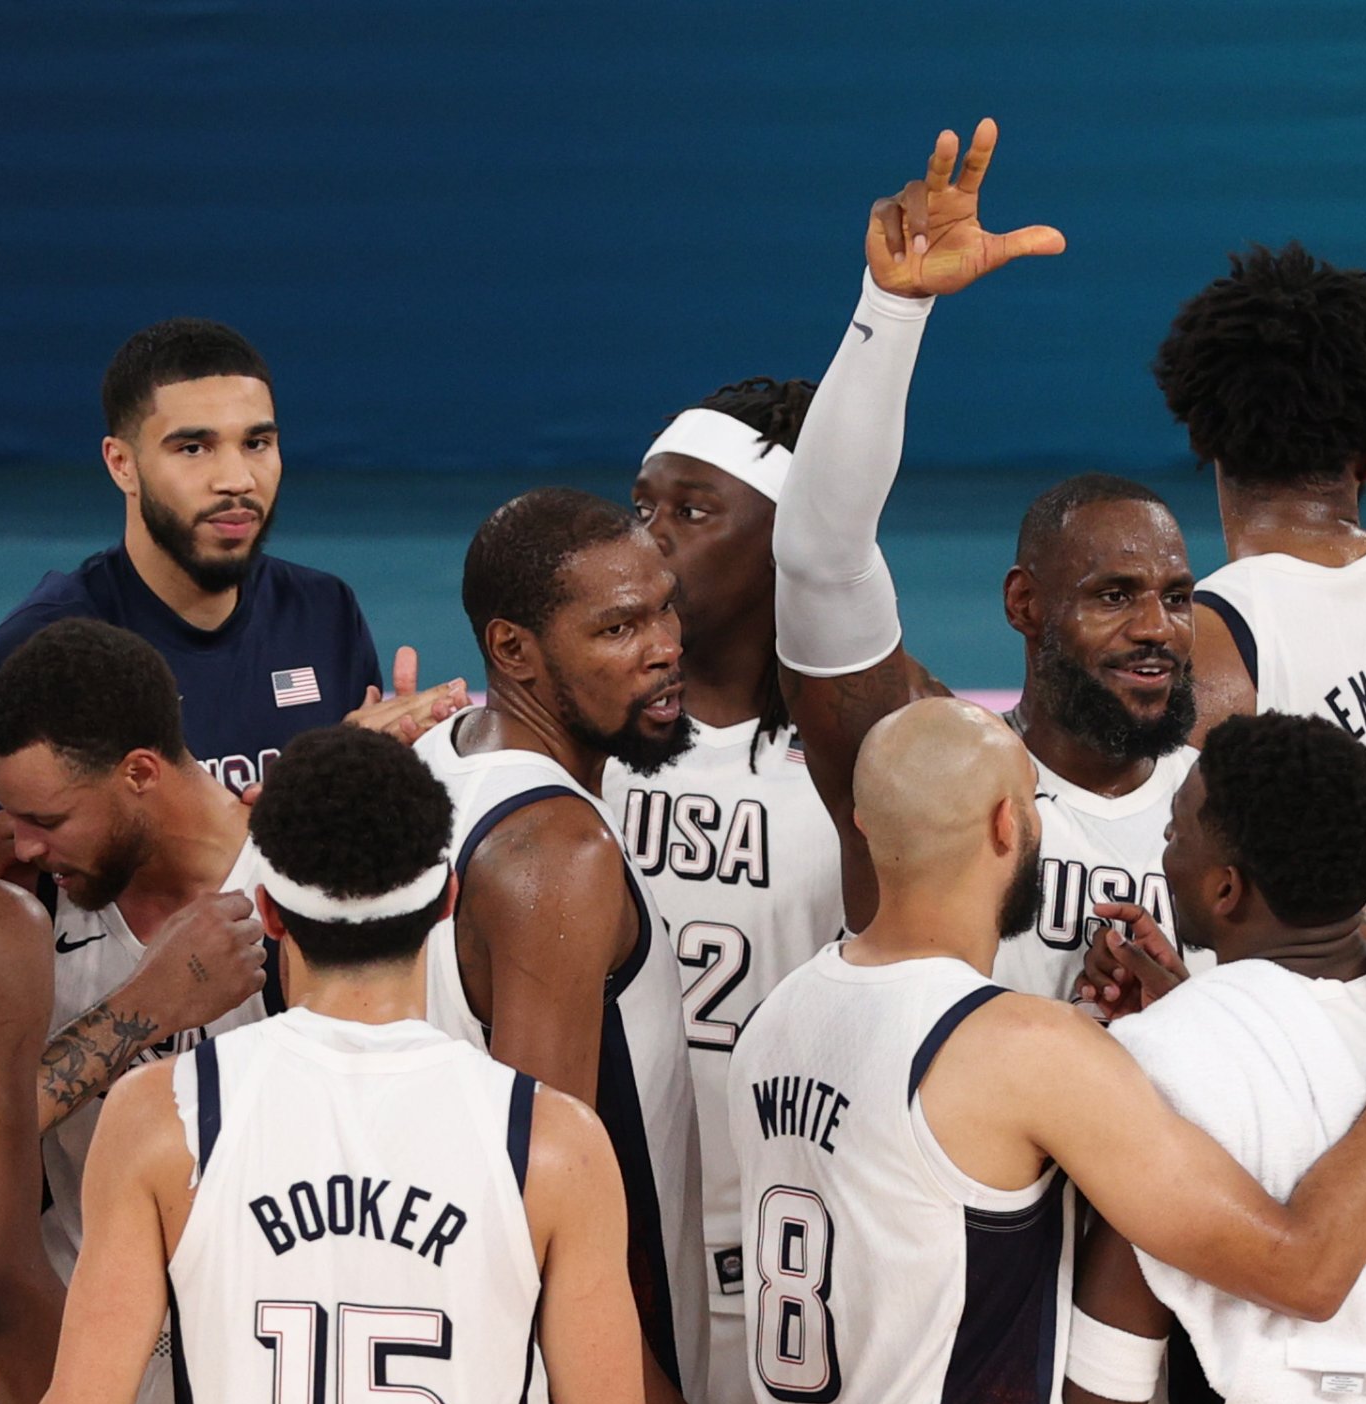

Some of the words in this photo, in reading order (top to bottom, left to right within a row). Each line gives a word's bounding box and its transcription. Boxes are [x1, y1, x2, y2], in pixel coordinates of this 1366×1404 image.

[623, 789, 770, 888] USA
[662, 916, 751, 1053] 2
[752, 1076, 851, 1155] WHITE
[249, 1174, 468, 1268] BOOKER
[755, 1184, 842, 1404] 8
